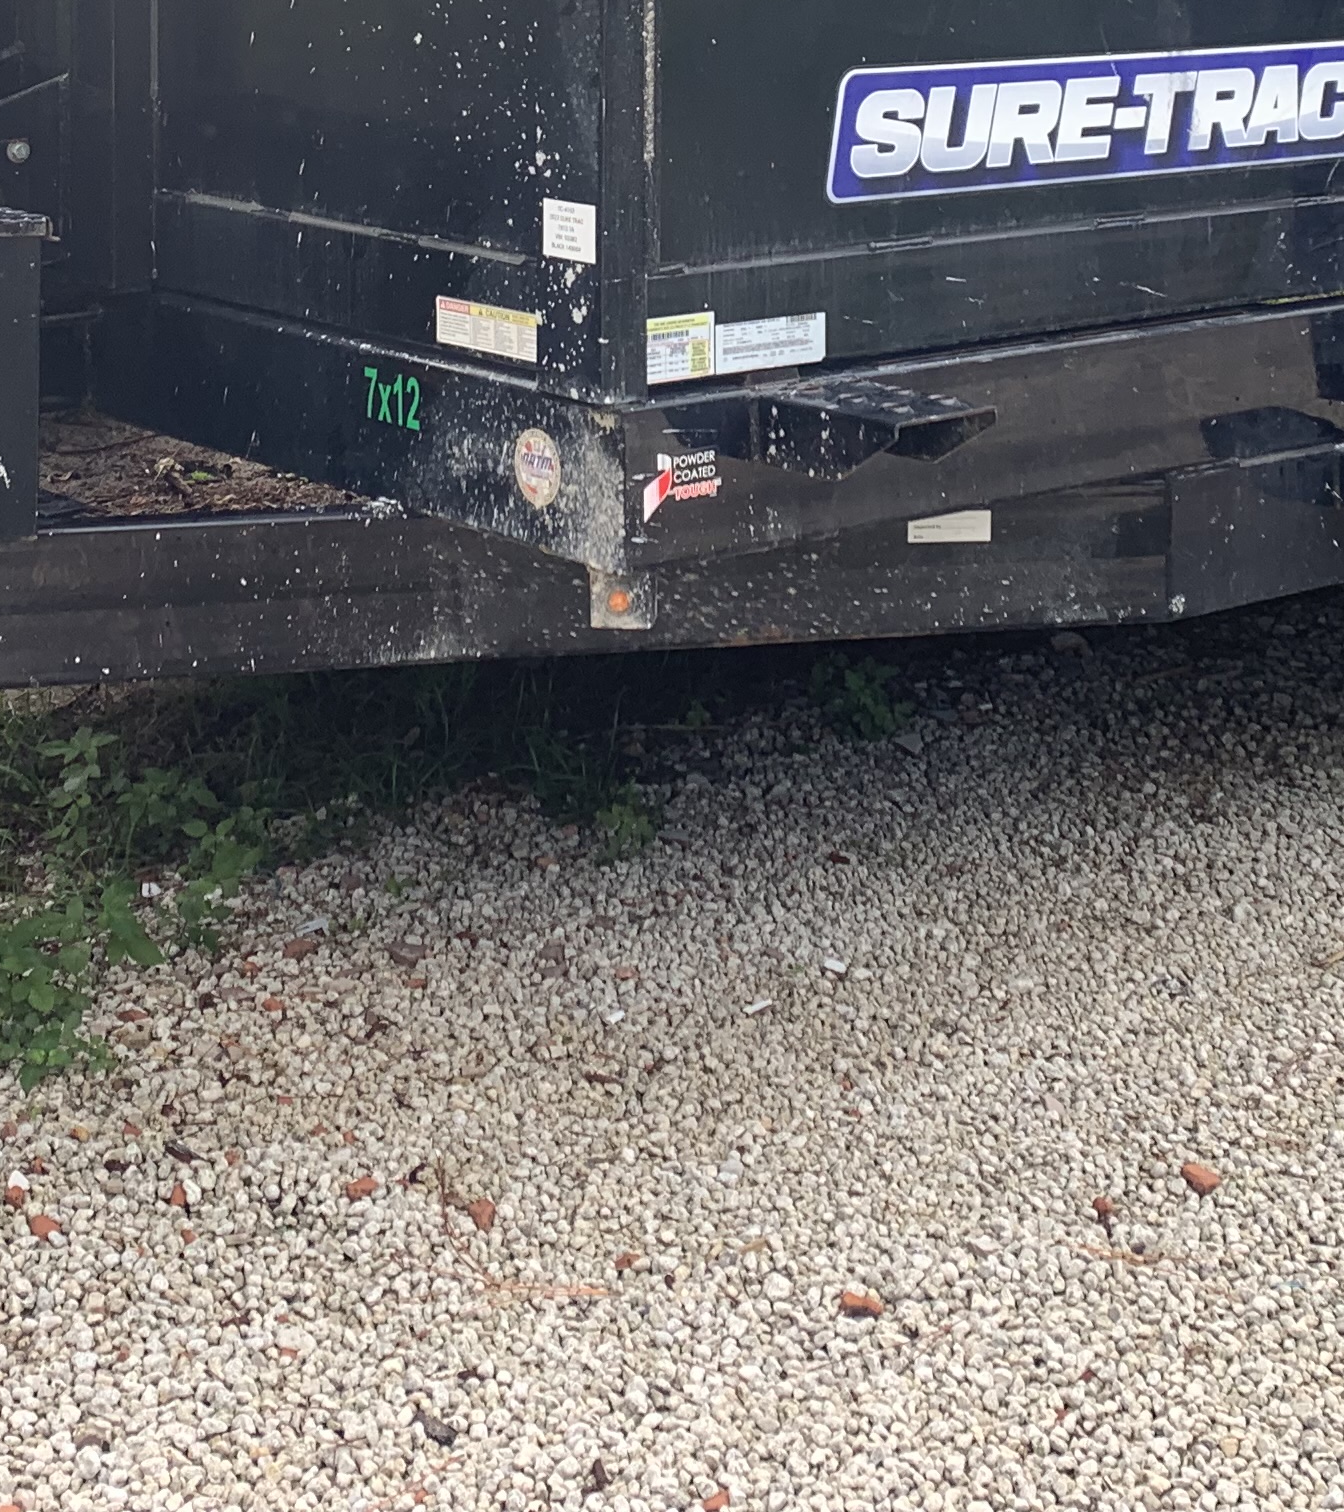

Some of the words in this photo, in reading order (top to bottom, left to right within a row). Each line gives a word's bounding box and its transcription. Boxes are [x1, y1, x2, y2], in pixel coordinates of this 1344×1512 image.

[485, 308, 510, 321] CAUTION
[364, 366, 421, 431] 7x12
[673, 450, 716, 468] POWDER
[673, 464, 716, 483] COATED
[674, 478, 717, 501] TOUGH
